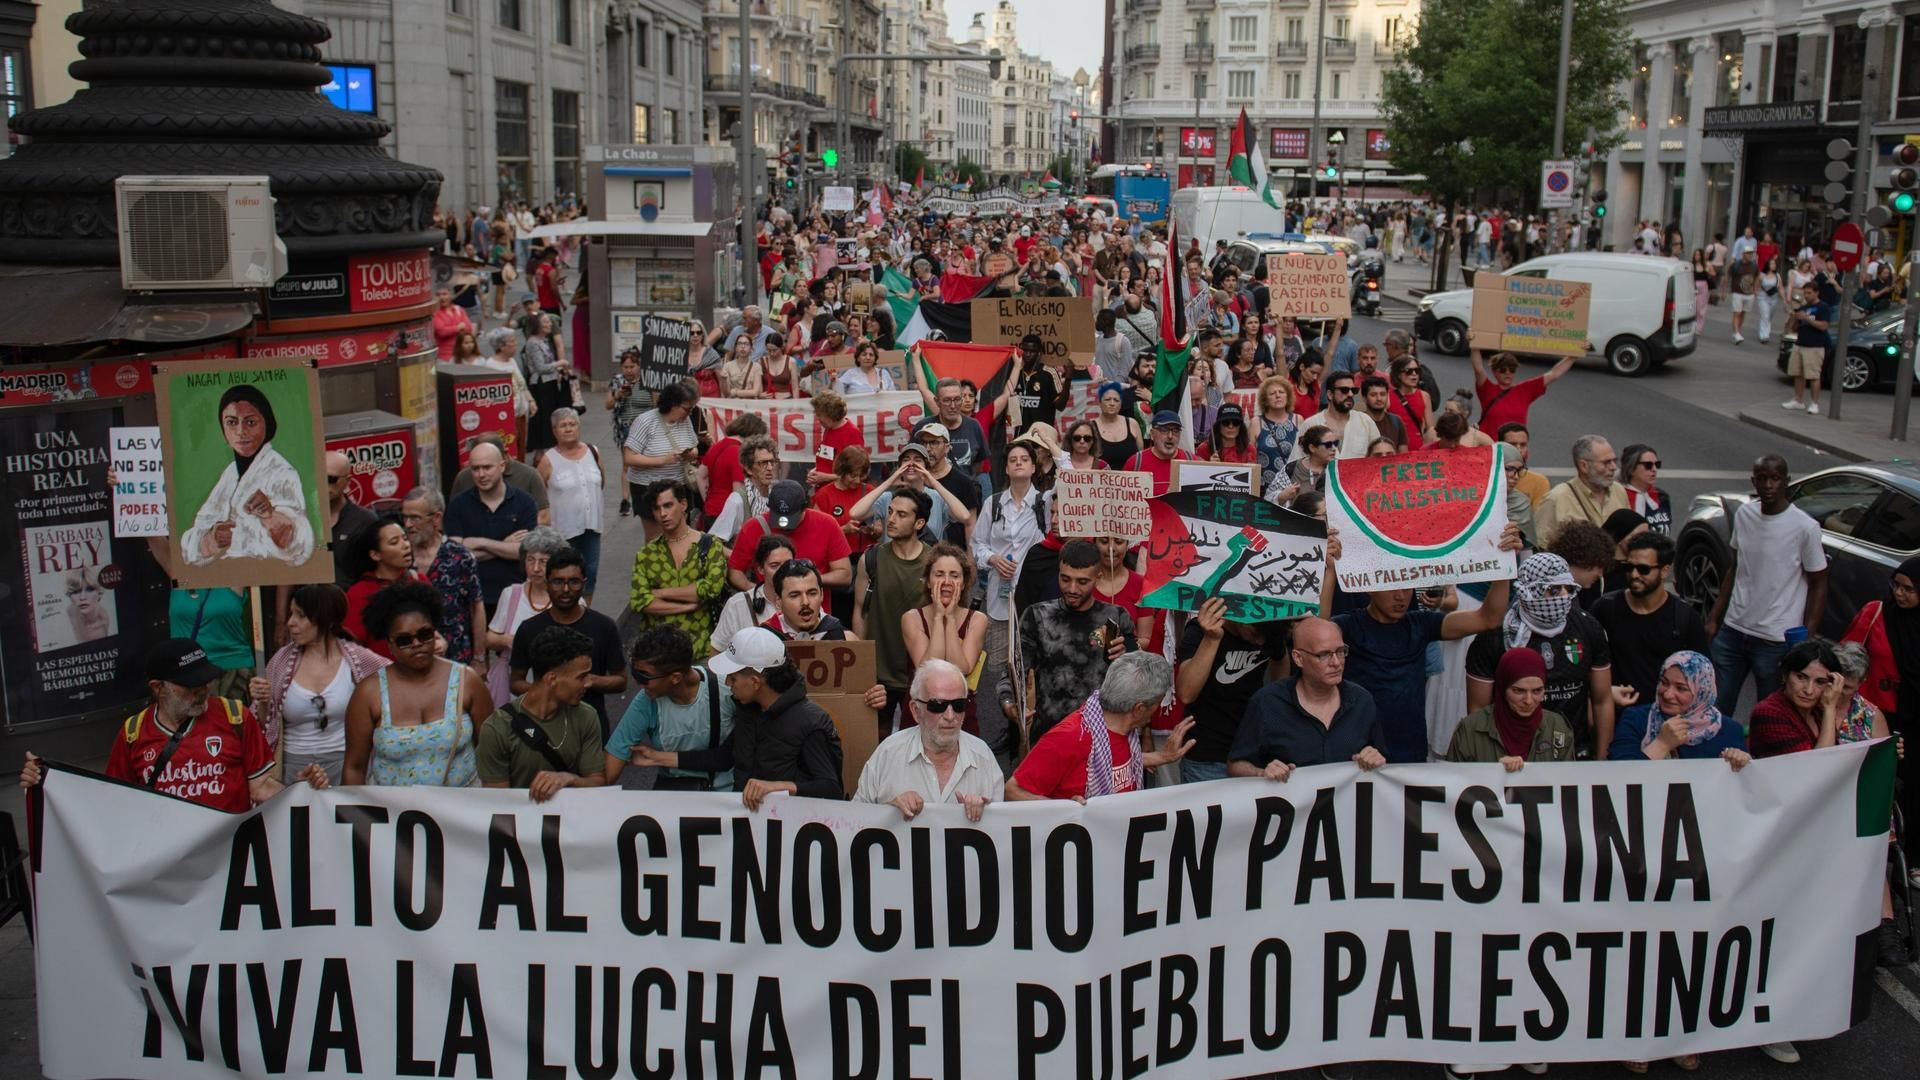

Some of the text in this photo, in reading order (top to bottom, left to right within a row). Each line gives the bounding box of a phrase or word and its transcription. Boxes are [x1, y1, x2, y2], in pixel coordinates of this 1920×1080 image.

[1706, 111, 1728, 124] HOTEL
[1730, 109, 1762, 123] MADRID
[1763, 107, 1786, 122] GRAN
[1803, 105, 1815, 120] 25
[605, 148, 620, 160] La
[622, 148, 659, 160] Chata
[357, 260, 413, 287] TOURS
[414, 261, 422, 281] &
[1270, 256, 1337, 272] EL NUEVO
[276, 279, 300, 292] GRUPO
[1270, 273, 1345, 285] REGLAMENTO
[1511, 281, 1564, 296] MIGRAR
[360, 287, 393, 302] Toledo
[1331, 288, 1345, 298] EL
[999, 299, 1013, 317] EL
[1284, 301, 1330, 313] ASILO
[661, 320, 690, 342] PADRÓN
[1000, 324, 1022, 337] NOS
[248, 343, 328, 359] EXCURSIONES
[653, 344, 686, 365] NO HAY
[0, 372, 66, 391] MADRID
[187, 373, 222, 387] NAGAM
[228, 371, 248, 384] ABU
[457, 384, 511, 403] MADRID
[35, 430, 80, 450] UNA
[117, 438, 162, 450] LAS V
[7, 447, 109, 473] HISTORIA
[346, 441, 404, 464] ADRID
[114, 460, 133, 472] NO
[354, 459, 401, 475] City Tour
[1381, 461, 1446, 483] FREE
[33, 469, 88, 491] REAL
[116, 481, 157, 495] NO SE
[1100, 473, 1141, 488] RECOGE
[42, 494, 87, 509] primera
[1068, 487, 1082, 498] LA
[1366, 484, 1479, 512] PALESTINE
[17, 508, 43, 520] toda
[46, 507, 60, 517] mi
[120, 503, 159, 516] PODER
[1062, 503, 1095, 516] QUIEN
[1196, 496, 1280, 526] FREE
[34, 526, 104, 546] BÁRBARA
[1063, 520, 1151, 537] LAS LECHUGAS
[1149, 522, 1221, 560] فلسطين
[37, 538, 104, 575] REY
[36, 648, 119, 672] LAS ESPERADAS
[788, 645, 856, 688] TOP
[1225, 650, 1261, 670] NIKE
[41, 660, 116, 681] MEMORIAS DE
[43, 670, 116, 692] BÁRBARA REY
[158, 776, 225, 799] ncerá
[219, 782, 1710, 953] ALTO AL GENOCIDIO EN PALESTINA
[131, 957, 363, 1075] ¡VIVA
[396, 959, 493, 1079] LA
[527, 963, 797, 1080] LUCHA
[1016, 938, 1291, 1080] PUEBLO
[1323, 917, 1775, 1042] PALESTINO!
